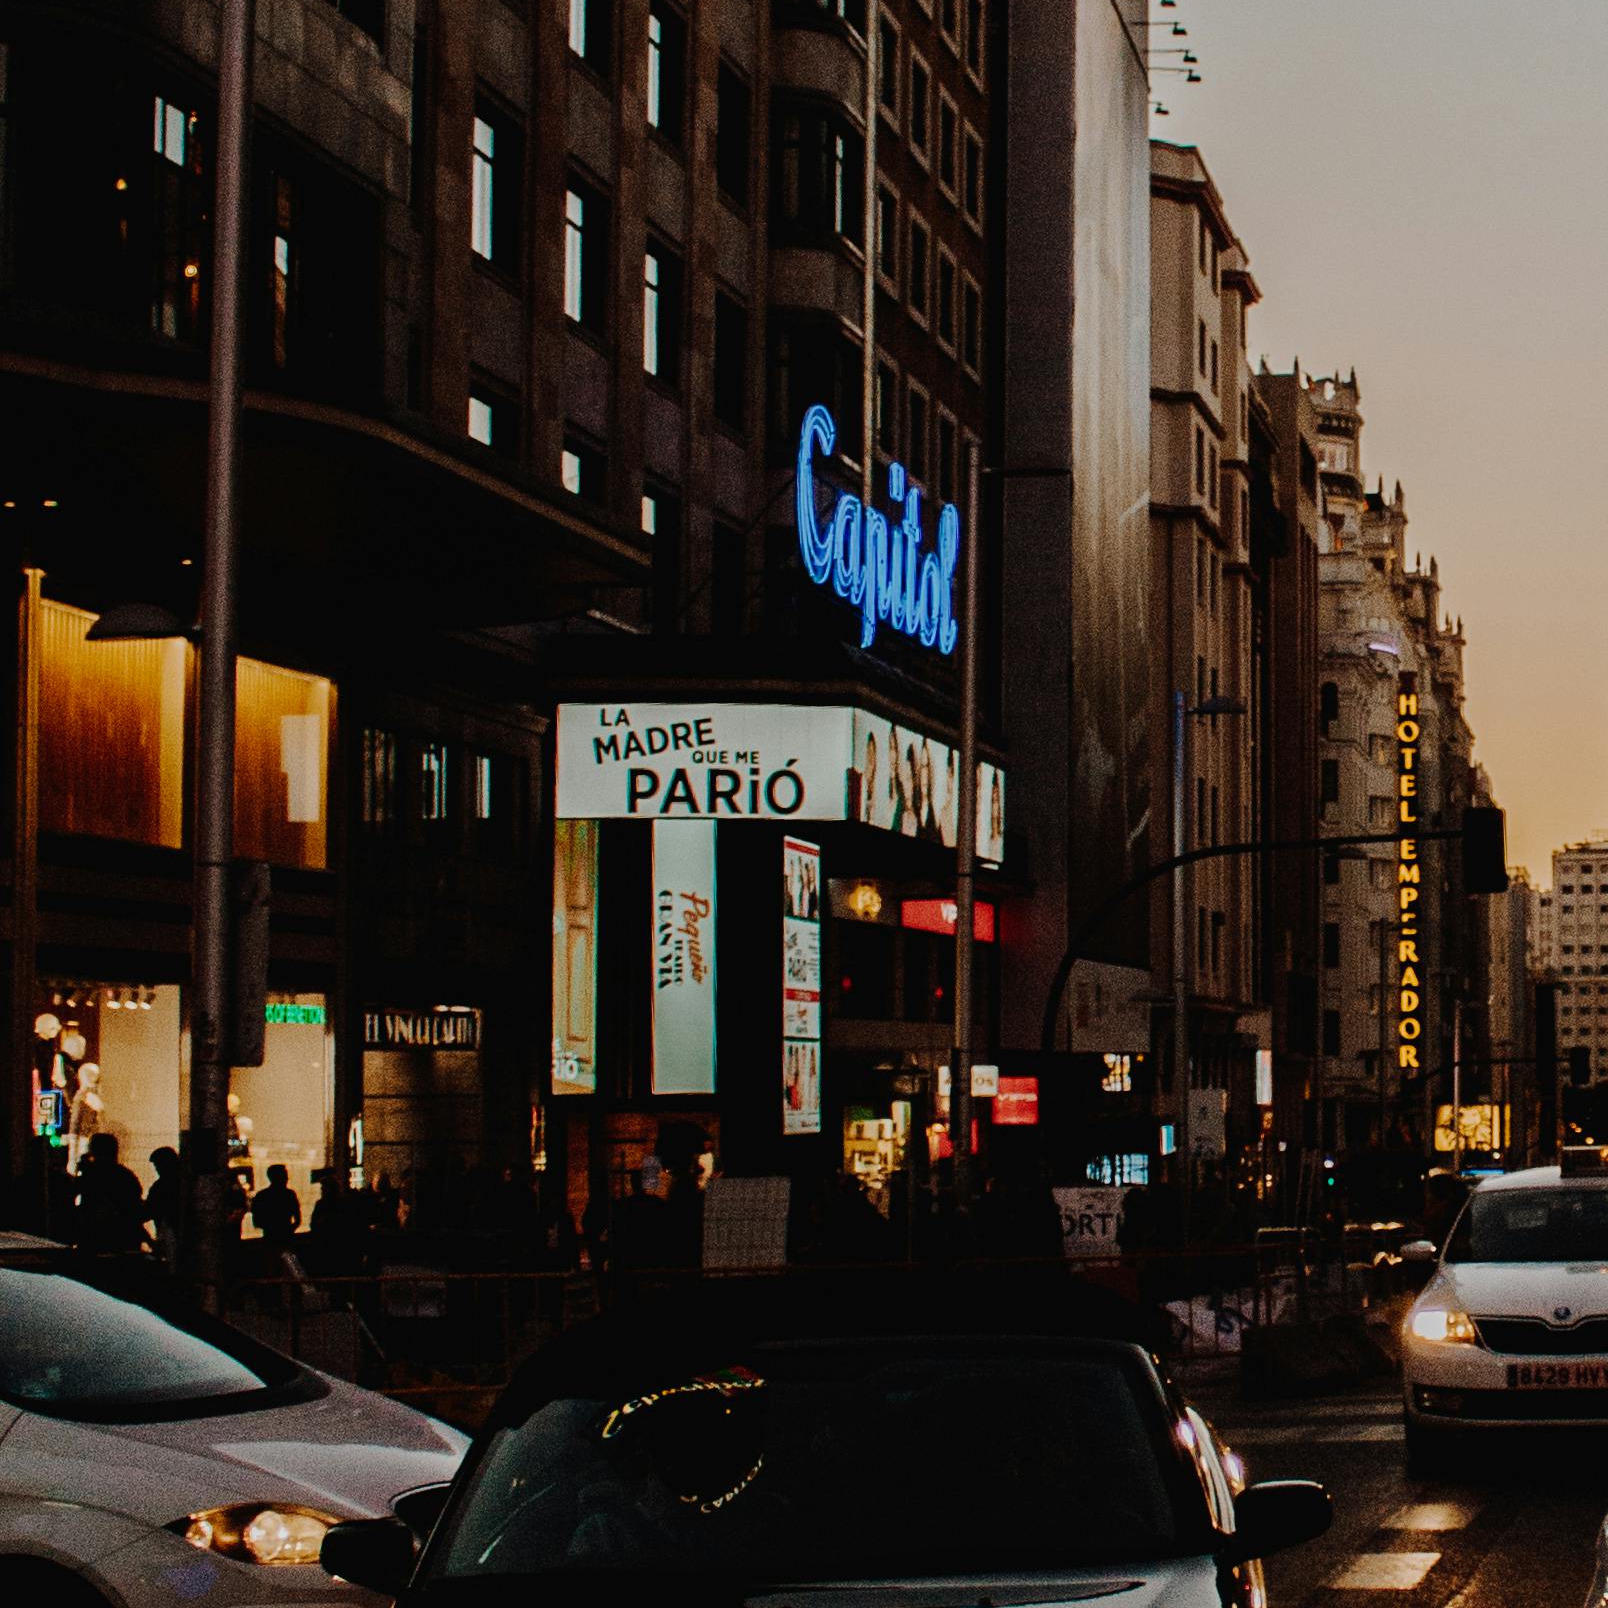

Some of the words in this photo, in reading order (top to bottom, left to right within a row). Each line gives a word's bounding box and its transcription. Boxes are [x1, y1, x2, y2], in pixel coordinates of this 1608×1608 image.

[796, 403, 960, 656] Capitol
[593, 717, 715, 764] MADRE
[600, 708, 629, 726] LA
[692, 751, 728, 764] QUE
[735, 751, 760, 764] ME
[1397, 694, 1420, 823] HOTEL
[680, 891, 709, 985] Pequeño
[1398, 838, 1420, 1068] EMPERADOR
